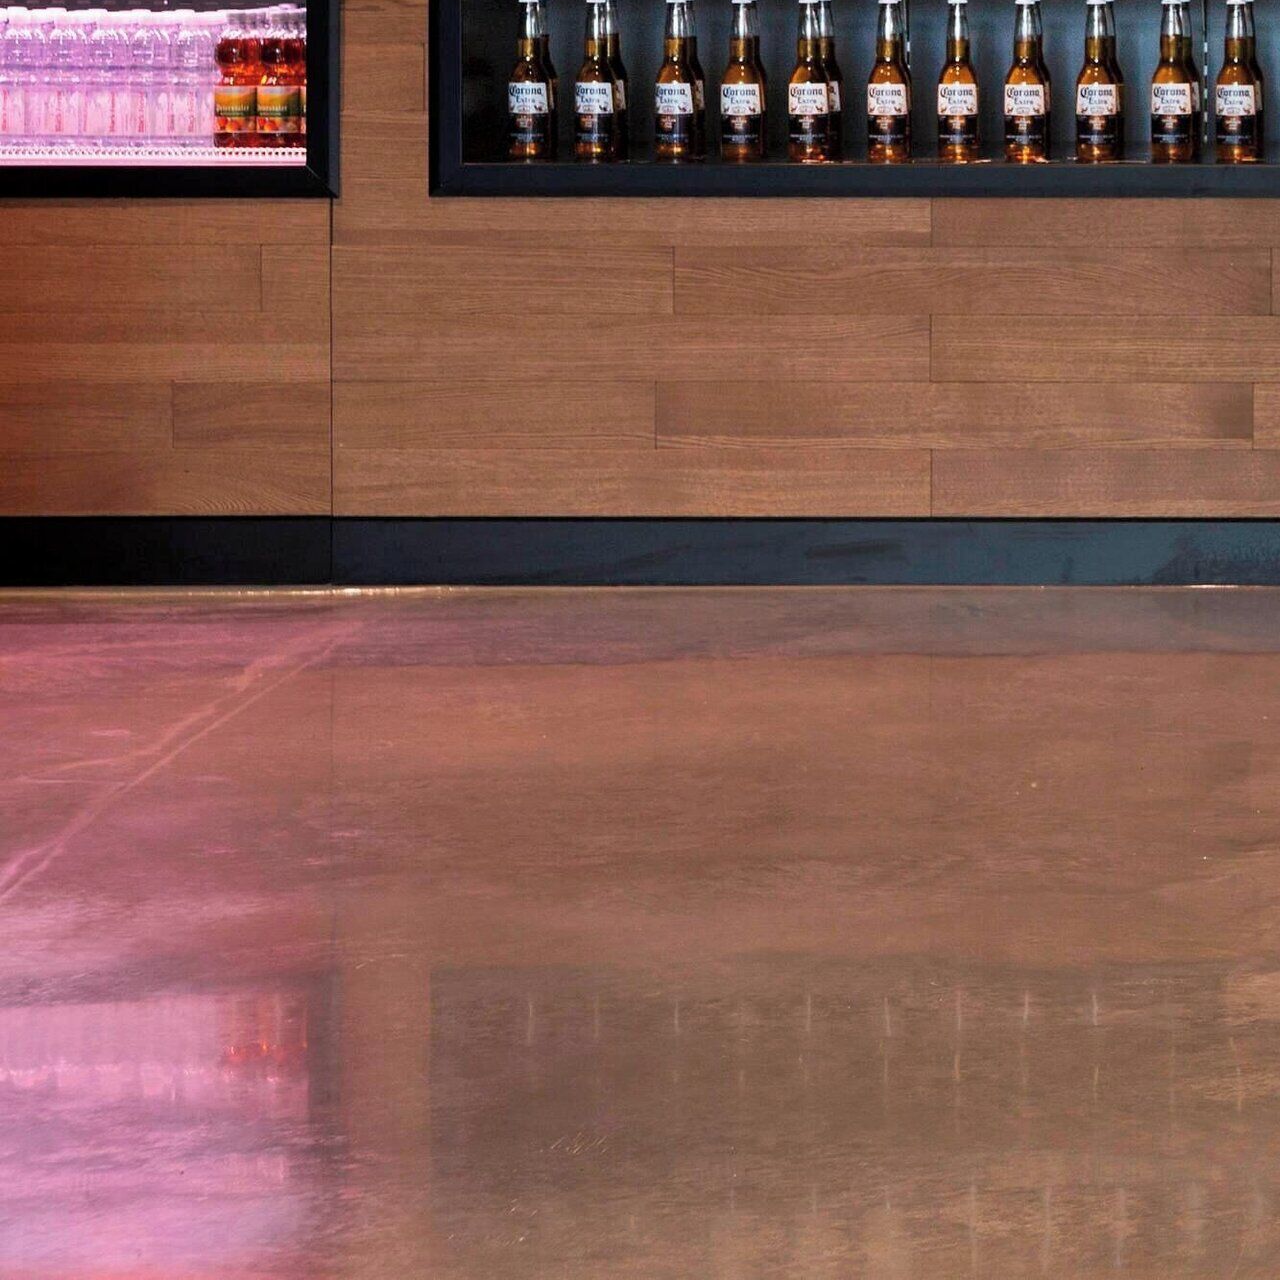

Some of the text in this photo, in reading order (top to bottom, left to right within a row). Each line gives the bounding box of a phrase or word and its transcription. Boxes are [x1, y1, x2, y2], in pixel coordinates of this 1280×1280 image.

[509, 86, 542, 96] Corona
[576, 86, 608, 96] Corona
[655, 86, 687, 96] Corona
[723, 86, 757, 96] Corona
[790, 86, 823, 96] Corona
[869, 87, 902, 97] Corona
[940, 87, 973, 97] Corona
[1006, 87, 1040, 97] Corona
[1080, 87, 1113, 97] Corona
[1153, 87, 1187, 97] Corona
[1217, 87, 1250, 97] Corona
